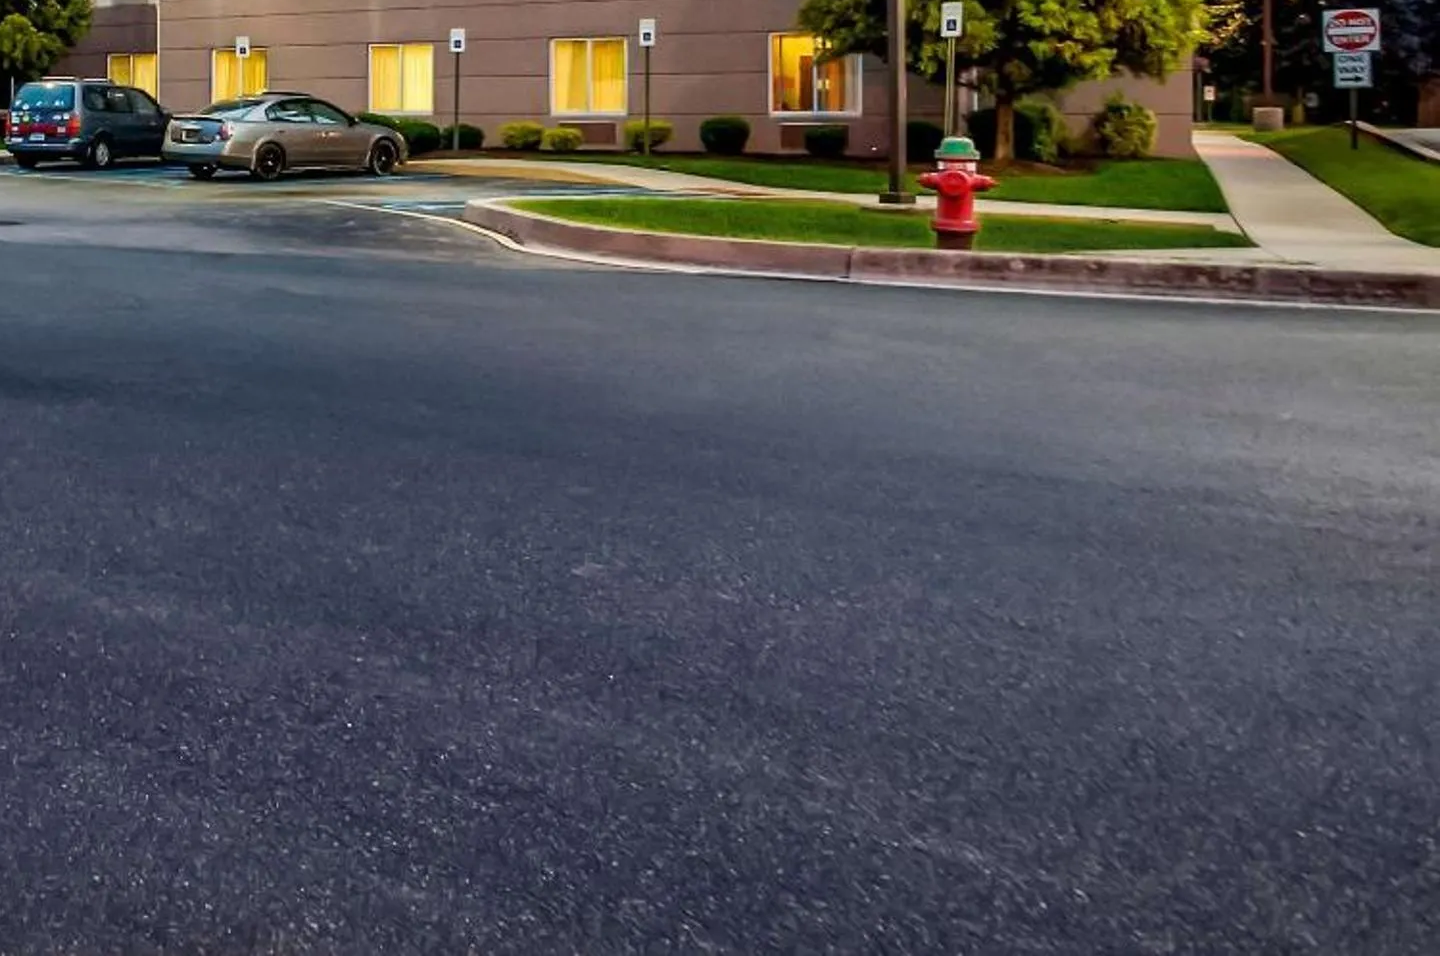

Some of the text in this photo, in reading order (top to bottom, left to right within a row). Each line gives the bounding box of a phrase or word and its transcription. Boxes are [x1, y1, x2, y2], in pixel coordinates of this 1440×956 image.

[1329, 17, 1372, 28] DO NOT
[1332, 35, 1371, 44] ENTER
[1338, 55, 1365, 63] ONE
[1338, 66, 1365, 74] WAY
